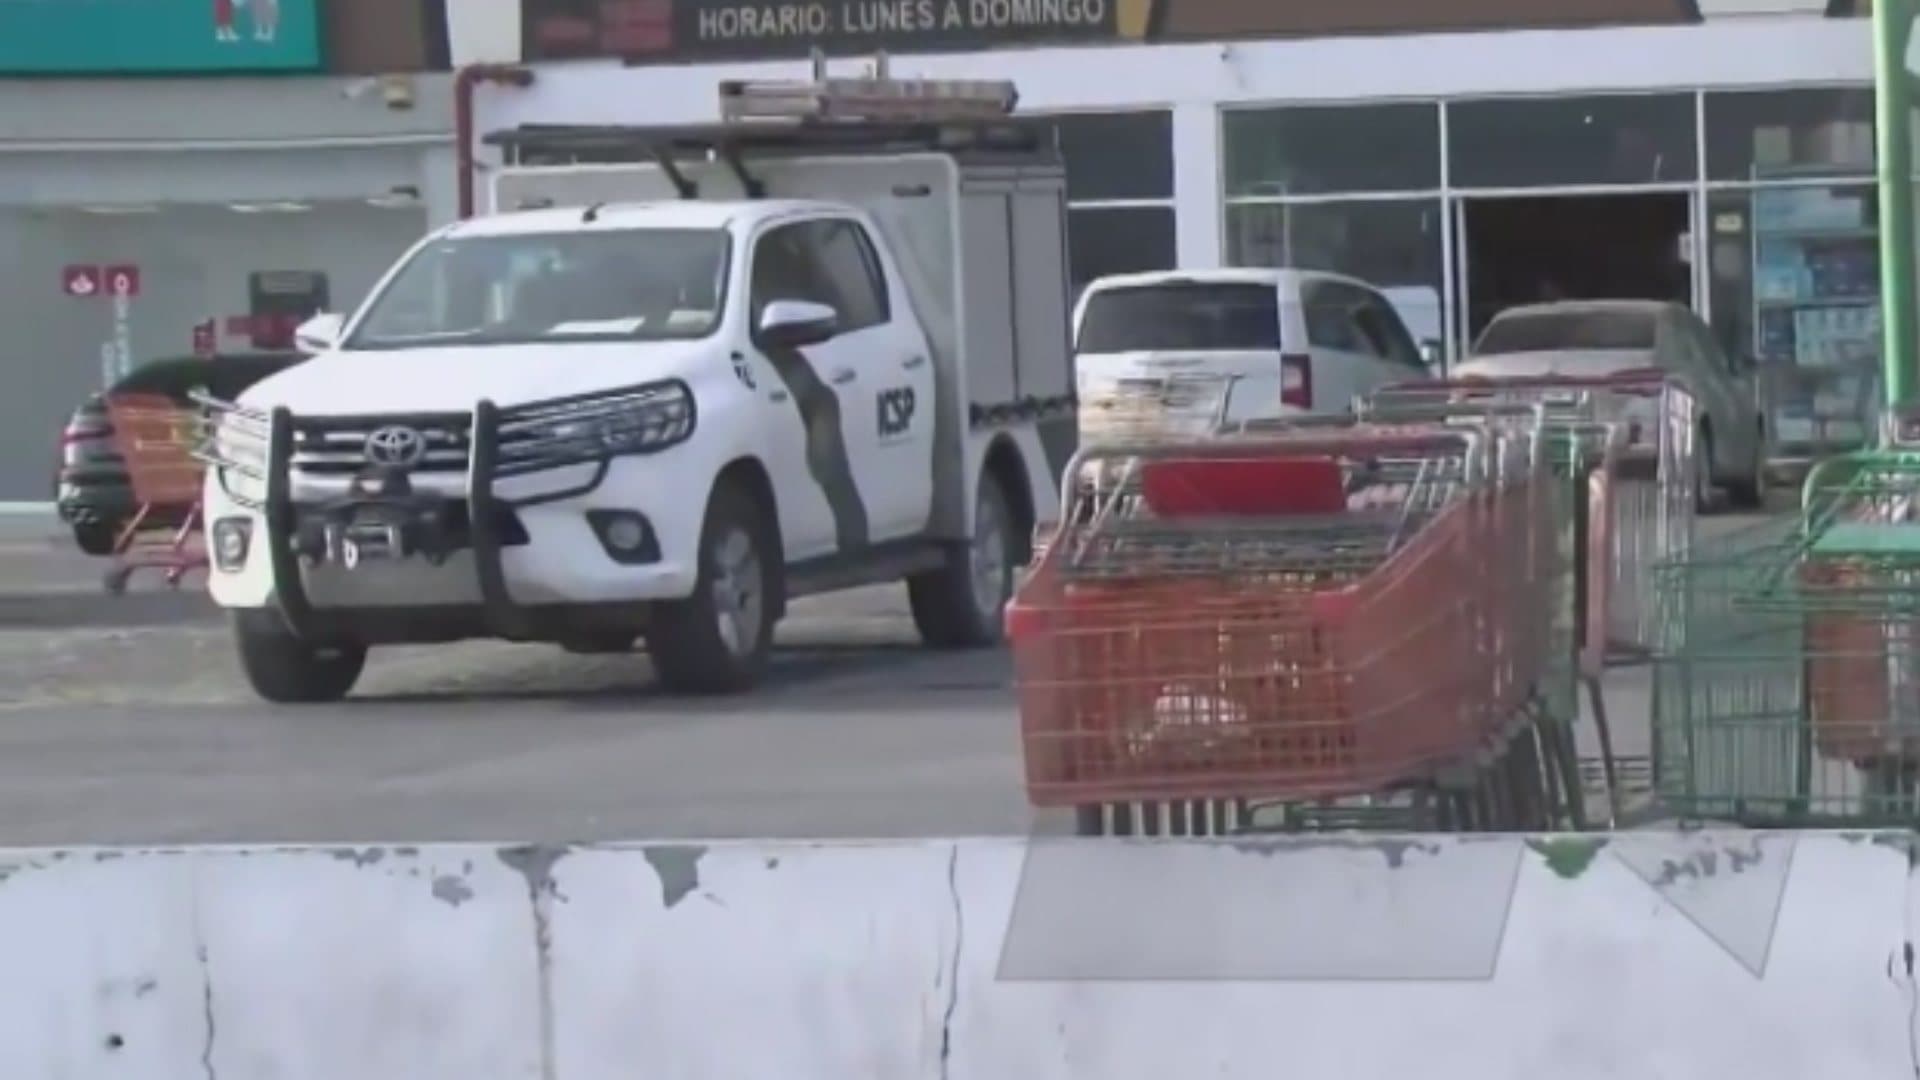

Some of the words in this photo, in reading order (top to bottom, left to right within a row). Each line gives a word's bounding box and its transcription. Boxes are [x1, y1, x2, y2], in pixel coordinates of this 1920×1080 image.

[699, 5, 833, 39] HORARIO:
[842, 0, 936, 32] LUNES
[941, 0, 963, 30] A
[970, 0, 1105, 27] DOMINGO
